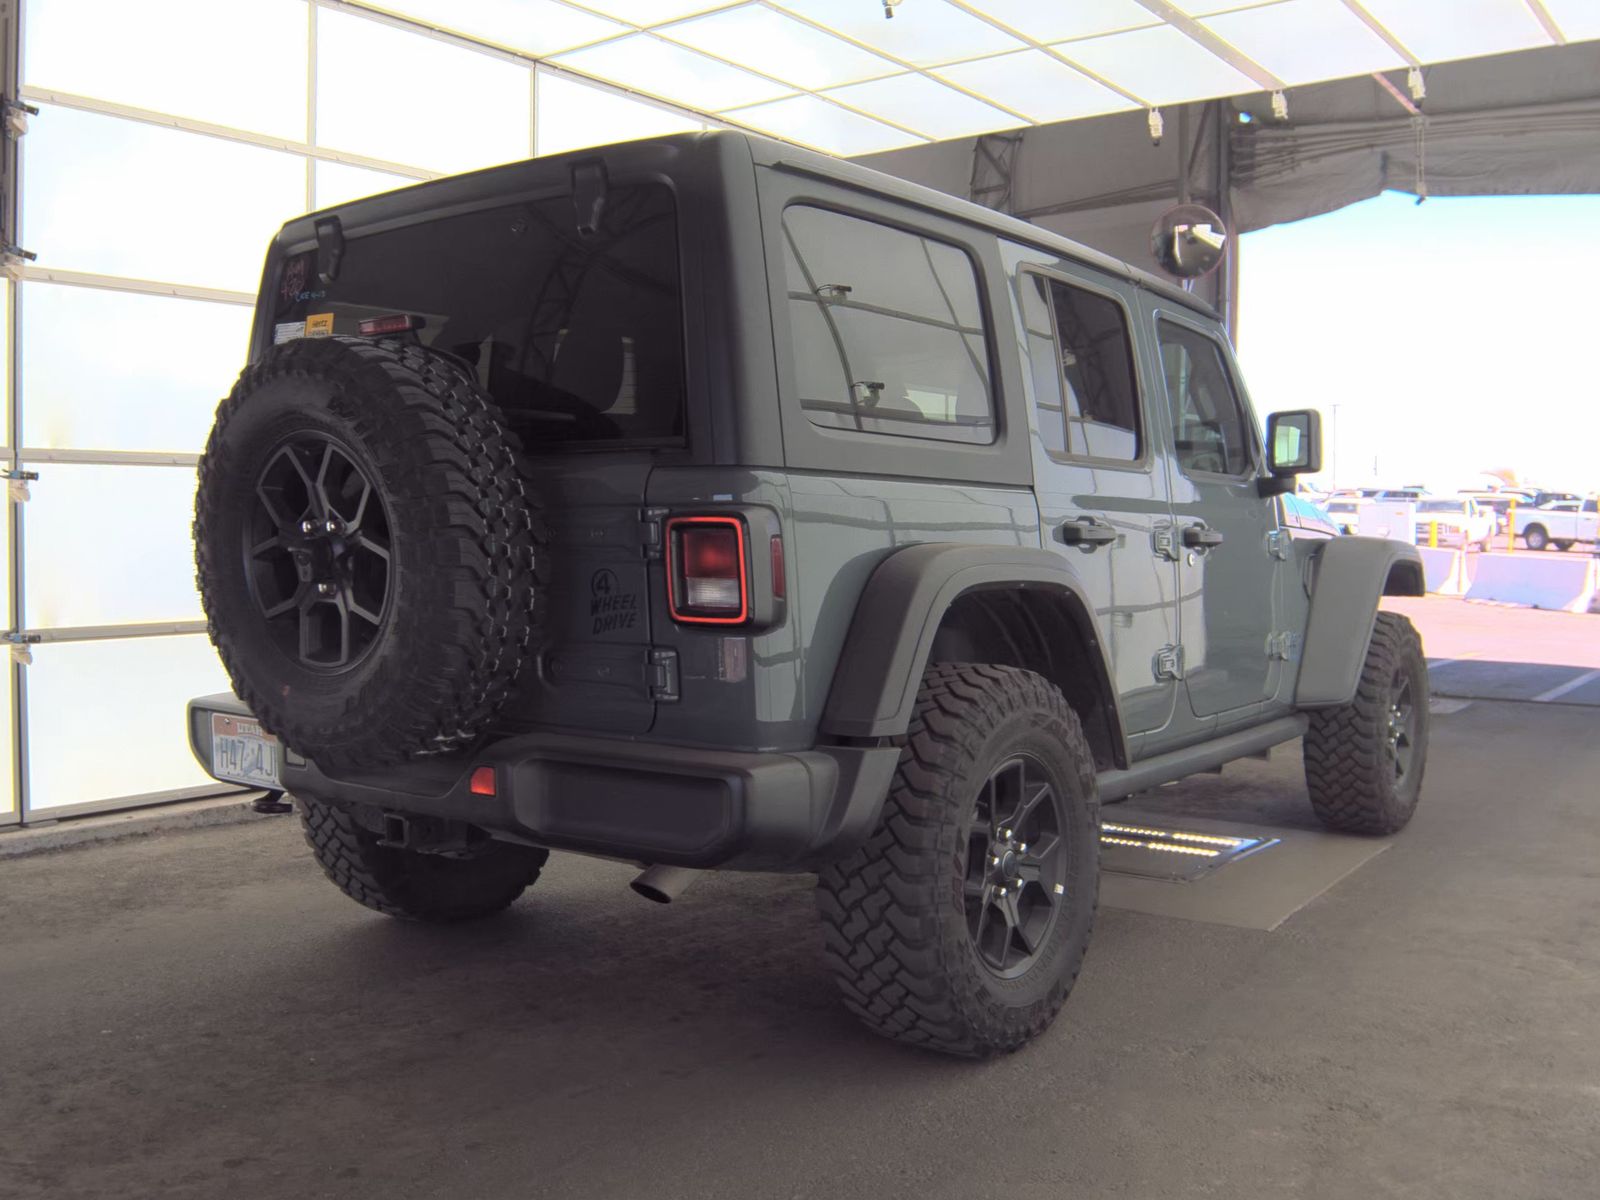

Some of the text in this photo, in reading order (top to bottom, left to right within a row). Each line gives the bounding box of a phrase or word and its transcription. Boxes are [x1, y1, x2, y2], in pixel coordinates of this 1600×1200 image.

[596, 572, 611, 594] 4
[590, 594, 637, 616] WHEEL
[592, 612, 638, 635] DRIVE
[220, 737, 245, 772] H47
